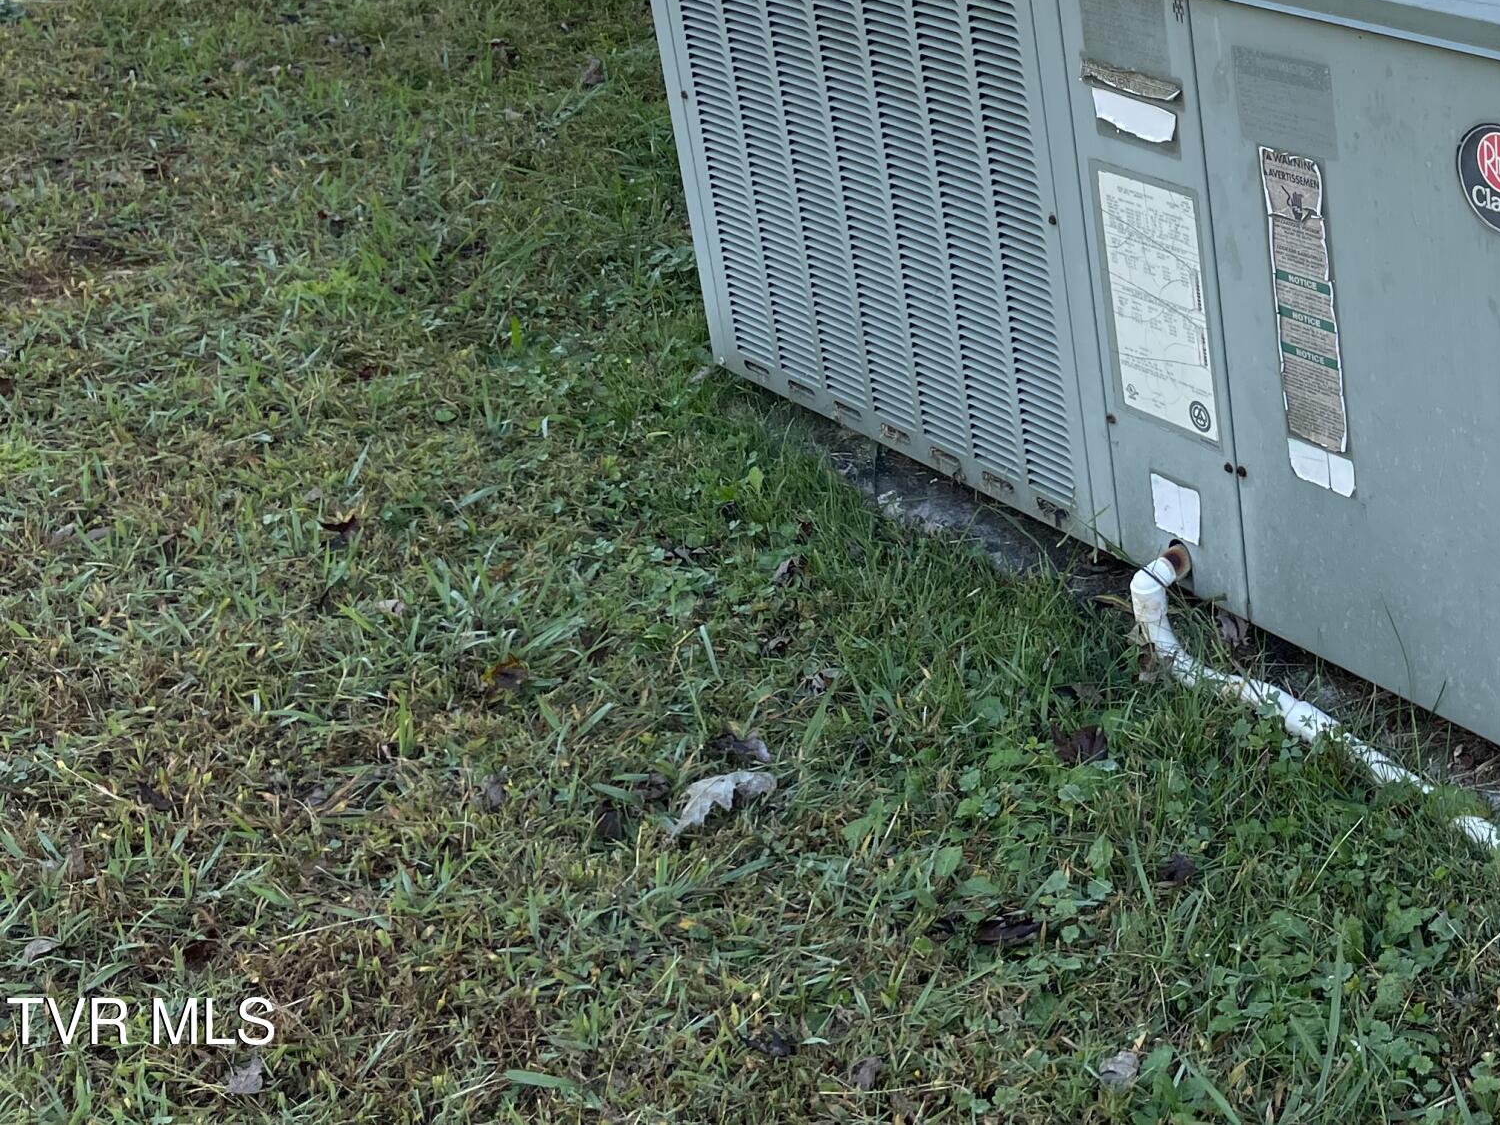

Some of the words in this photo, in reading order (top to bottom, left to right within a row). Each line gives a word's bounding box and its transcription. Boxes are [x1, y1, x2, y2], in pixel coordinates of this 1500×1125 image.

[1288, 275, 1317, 290] NOTICE
[1292, 311, 1321, 327] NOTICE
[1296, 348, 1325, 364] NOTICE
